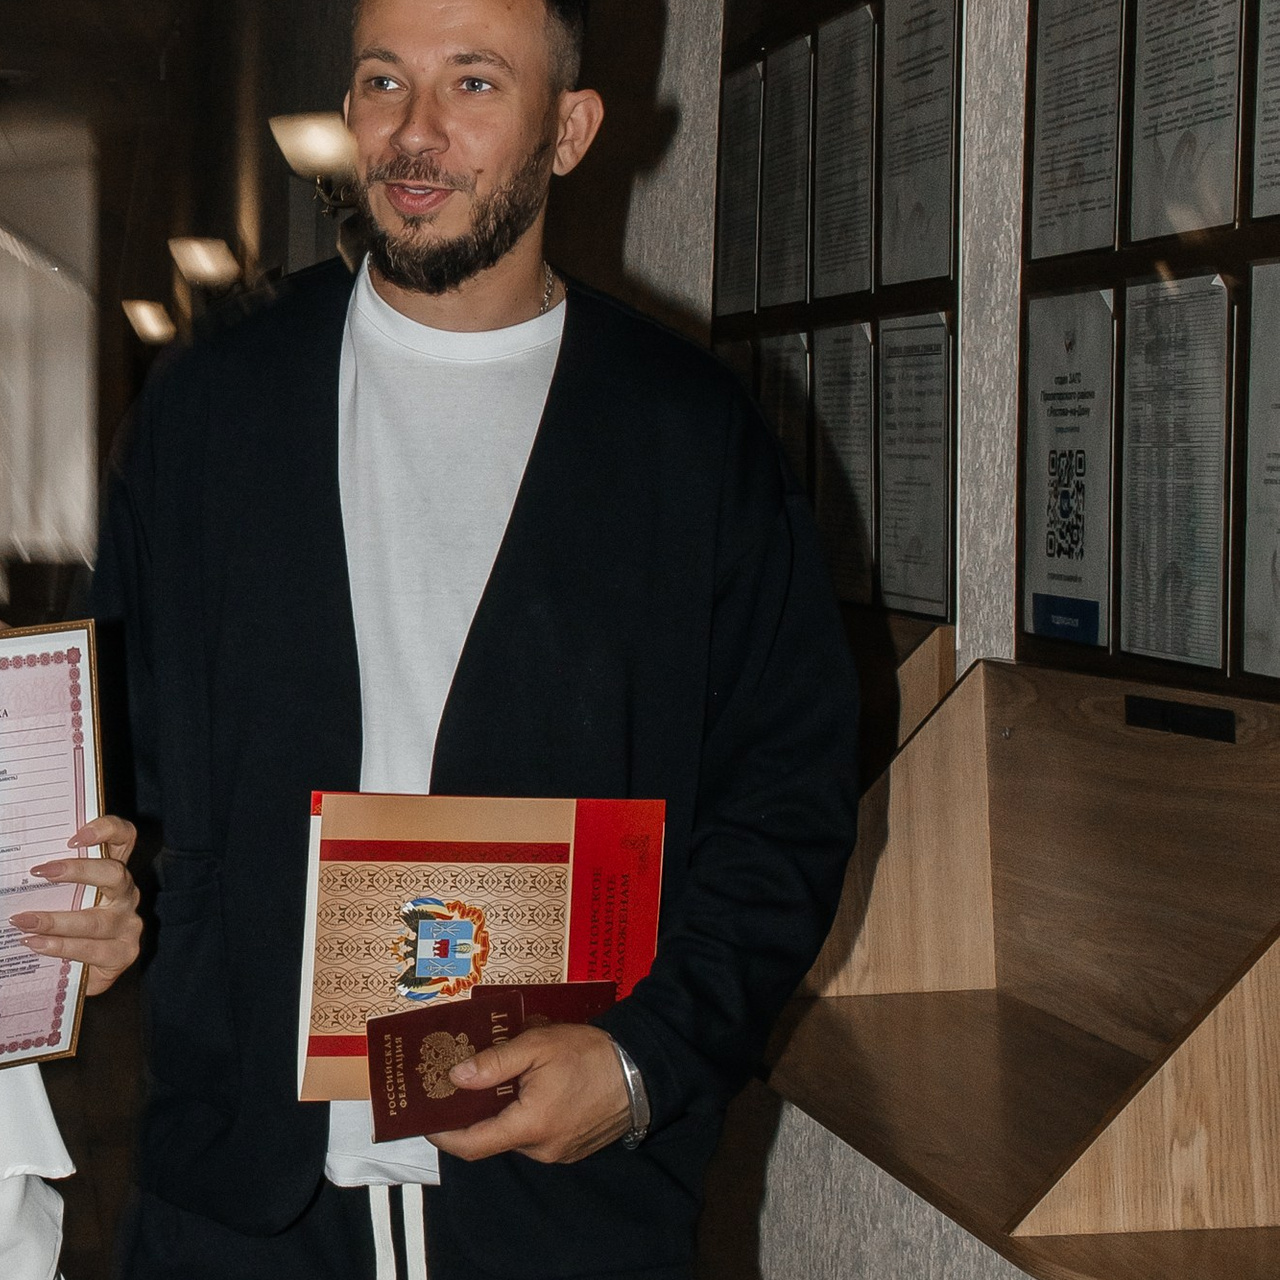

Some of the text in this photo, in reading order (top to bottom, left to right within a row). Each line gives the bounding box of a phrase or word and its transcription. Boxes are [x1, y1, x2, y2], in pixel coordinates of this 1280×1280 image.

[384, 1034, 397, 1116] РОССИЙСКАЯ
[395, 1037, 407, 1108] ФЕДЕРАЦИЯ
[491, 1012, 514, 1096] ПОРТ
